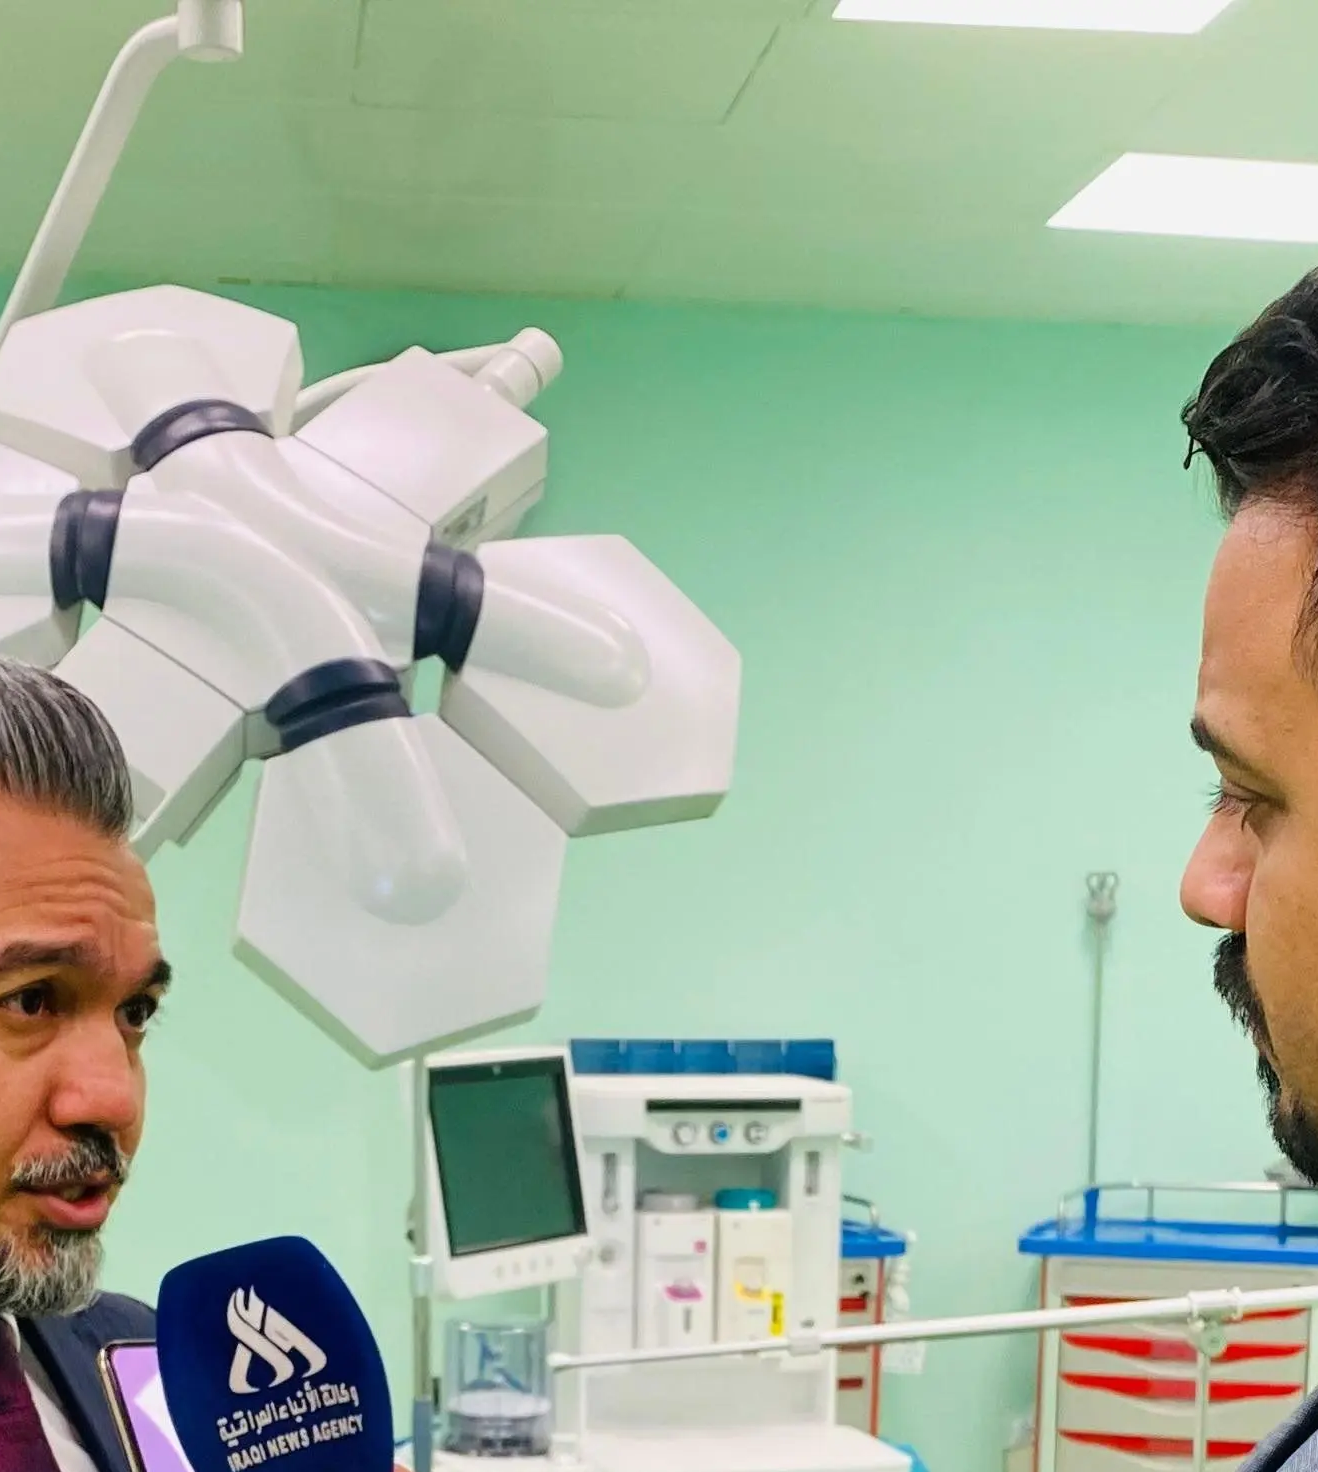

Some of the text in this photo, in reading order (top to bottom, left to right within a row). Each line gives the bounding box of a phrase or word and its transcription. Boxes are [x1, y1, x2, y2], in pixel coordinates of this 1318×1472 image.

[217, 1381, 359, 1447] وكالة الأنباء العراقية
[227, 1414, 363, 1472] IRAQI NEWS AGENCY
